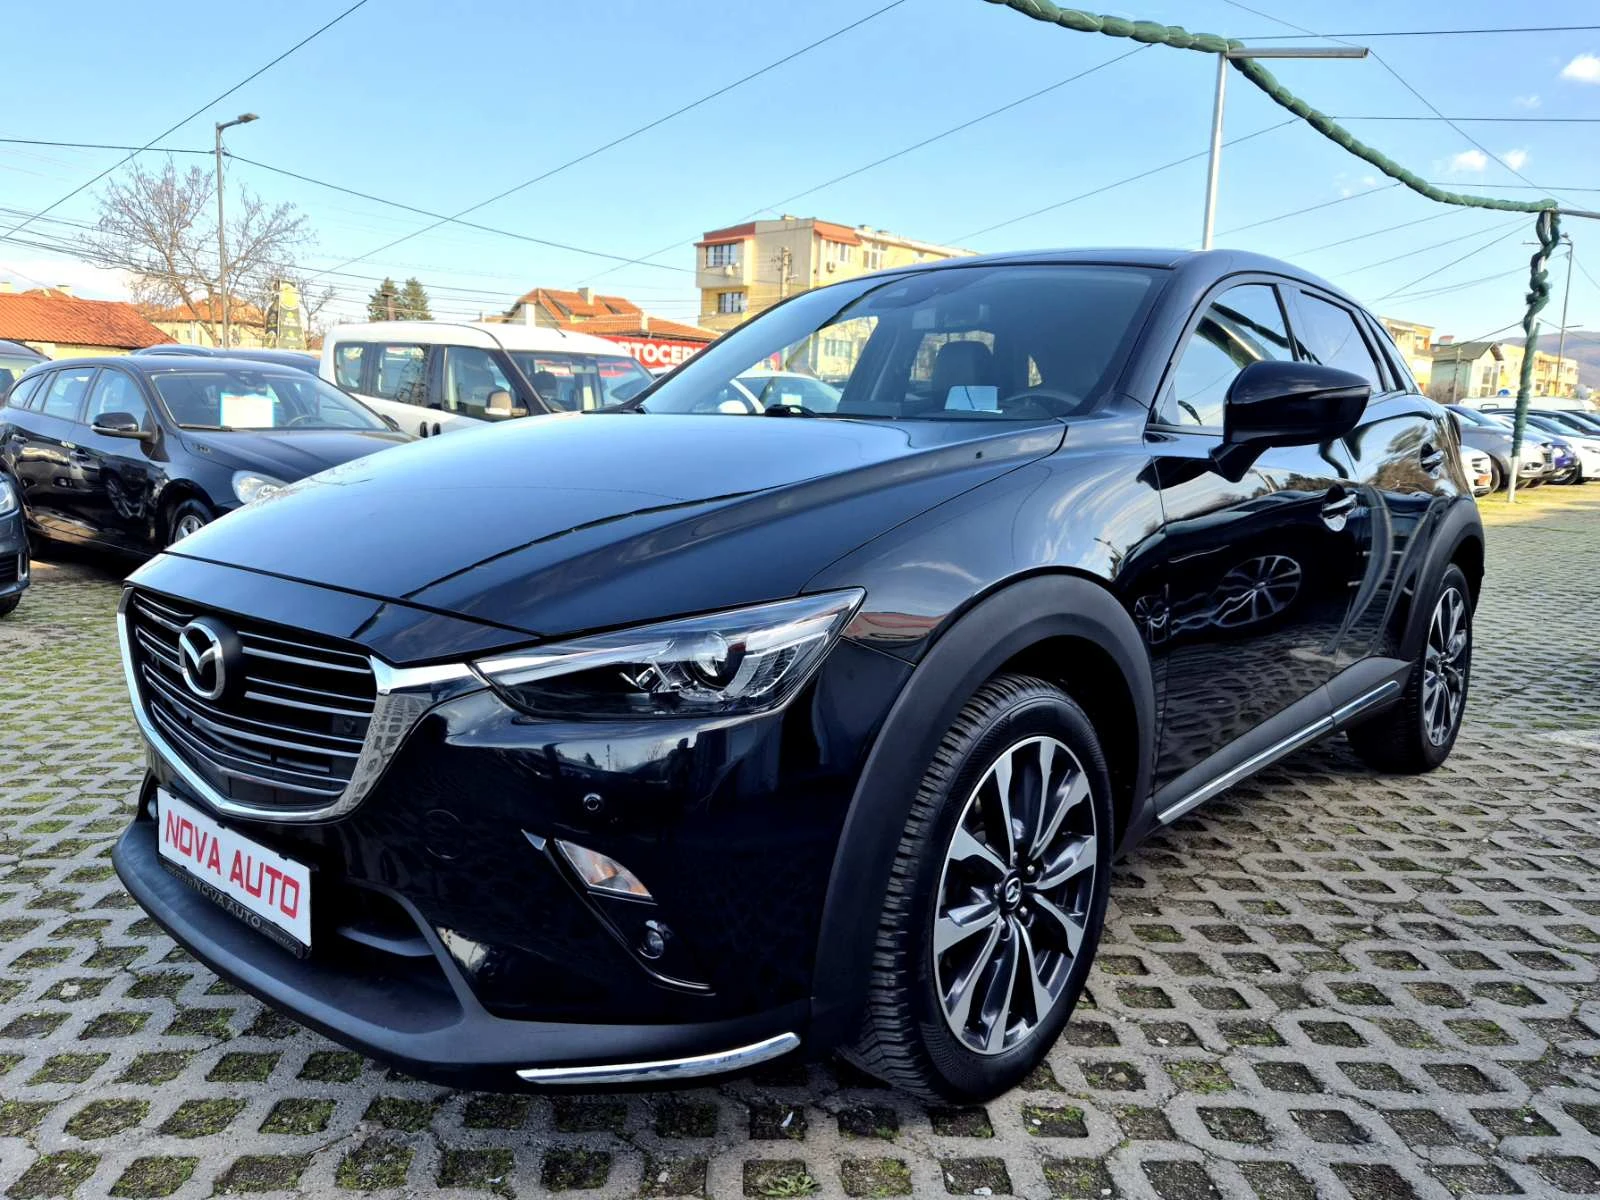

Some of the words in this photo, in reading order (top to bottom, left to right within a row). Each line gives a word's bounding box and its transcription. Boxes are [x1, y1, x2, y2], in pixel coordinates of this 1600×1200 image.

[616, 341, 701, 365] ТОСЕР
[166, 809, 221, 876] NOVA
[229, 850, 300, 919] AUTO
[193, 879, 225, 907] NOVA
[226, 902, 260, 929] AUTO
